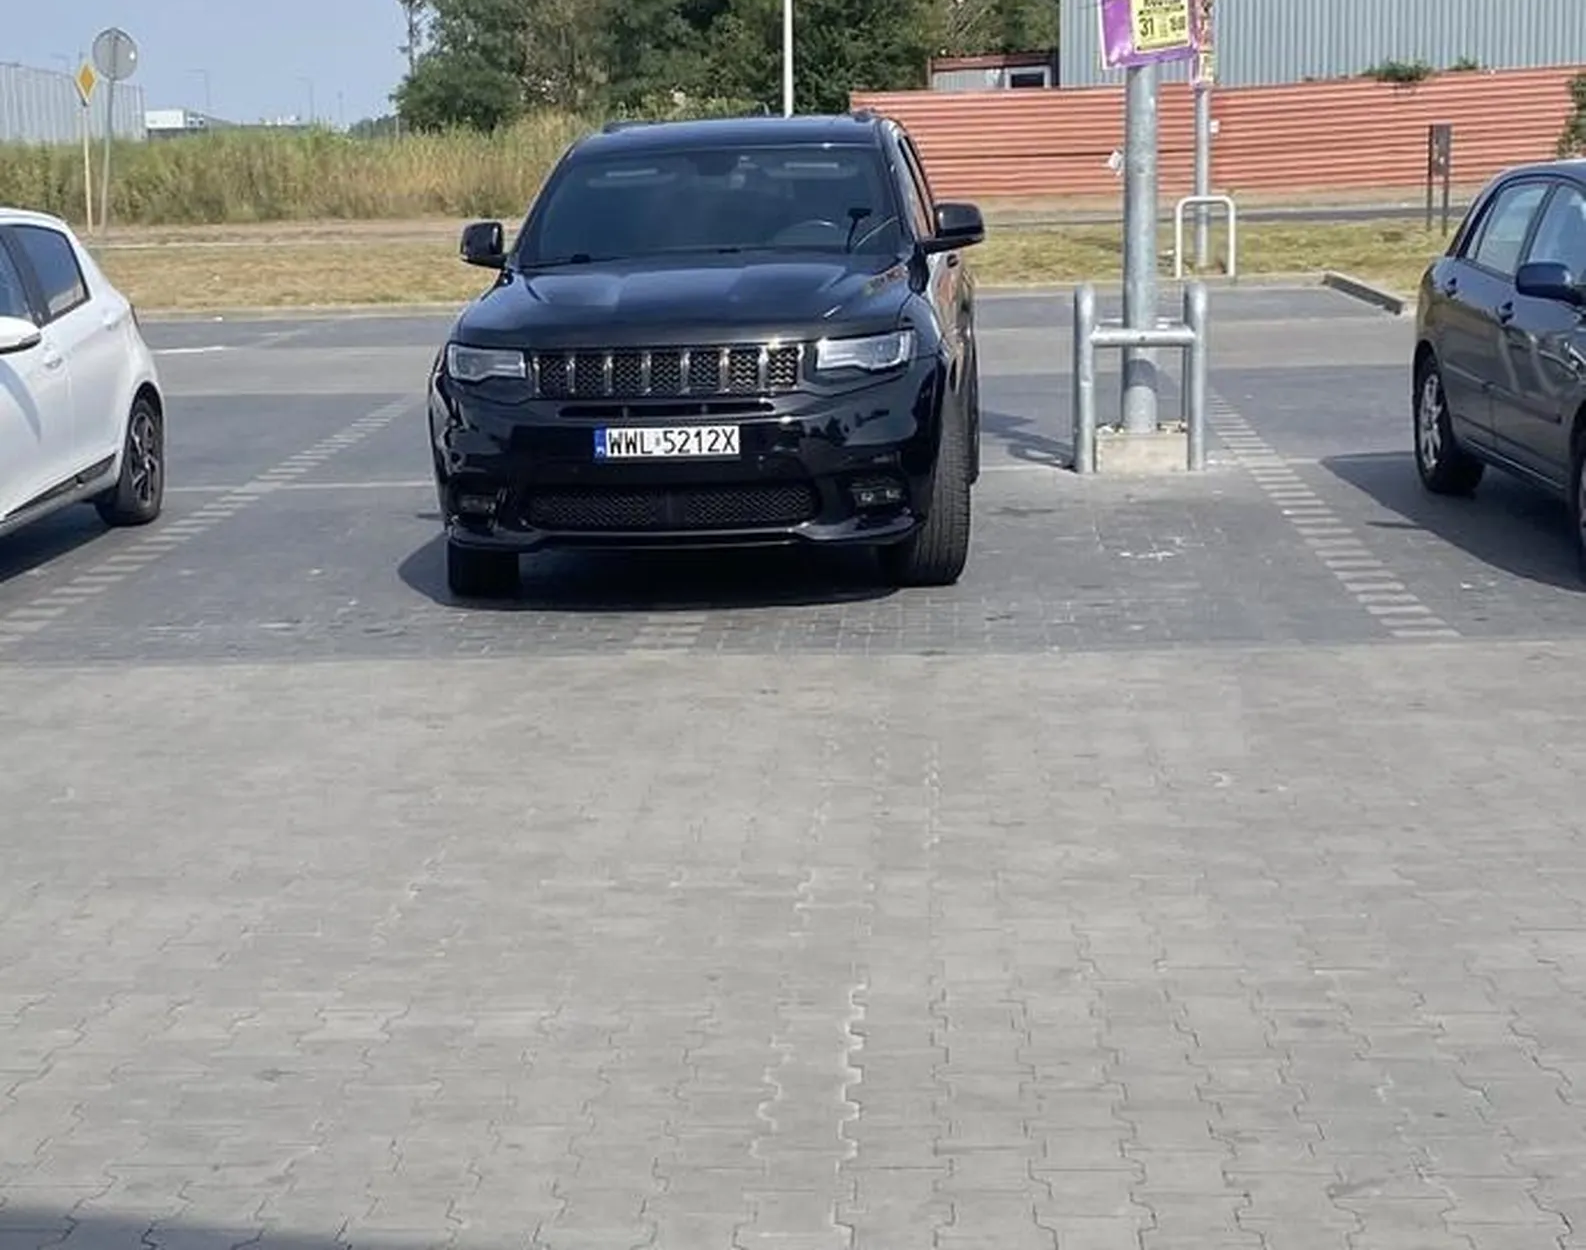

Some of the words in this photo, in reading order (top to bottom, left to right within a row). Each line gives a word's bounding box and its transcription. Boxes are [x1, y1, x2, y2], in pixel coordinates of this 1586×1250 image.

[1138, 17, 1155, 37] 31
[608, 429, 653, 455] WWL
[663, 428, 736, 454] 5212X
